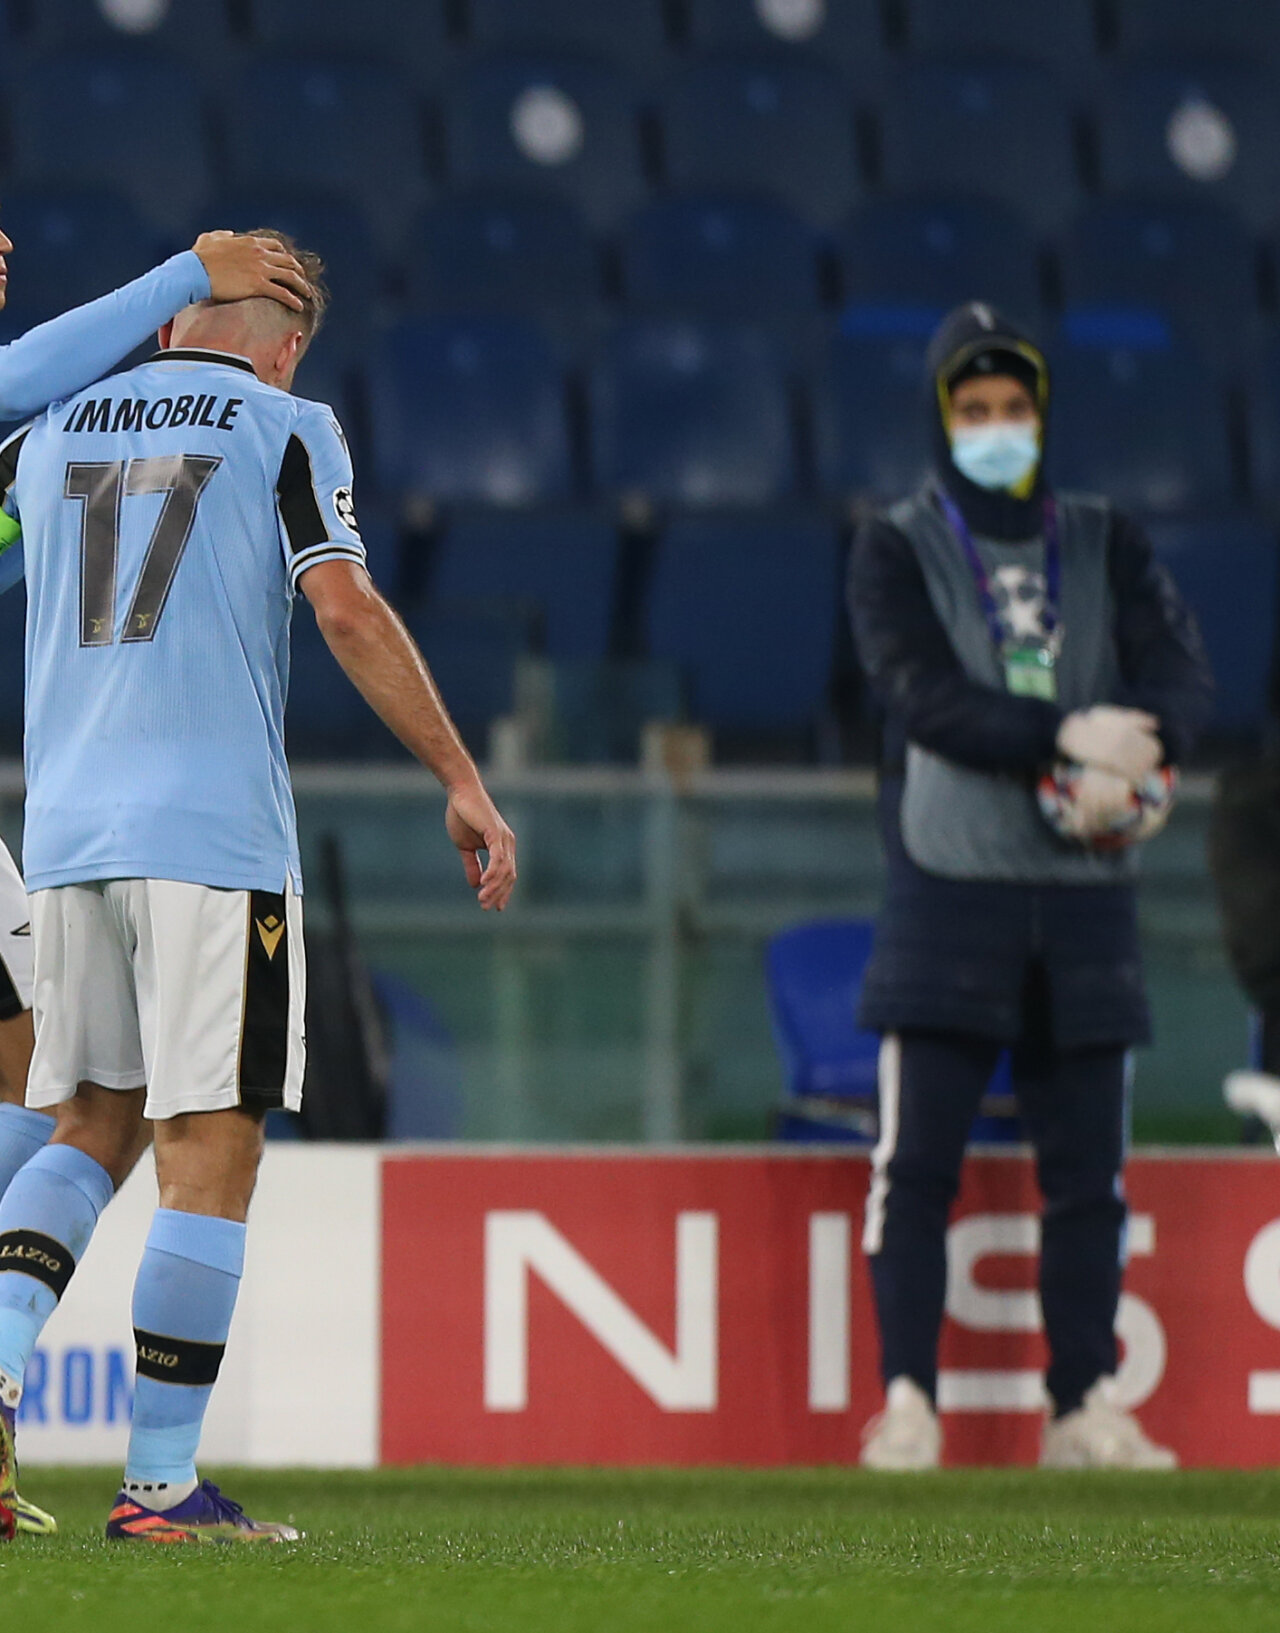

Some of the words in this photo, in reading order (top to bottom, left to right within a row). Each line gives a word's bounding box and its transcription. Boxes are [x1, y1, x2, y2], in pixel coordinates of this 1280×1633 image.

[63, 394, 243, 432] IMMOBILE
[64, 453, 224, 648] 17
[136, 1343, 179, 1368] AZIO
[484, 1211, 1280, 1414] NIS
